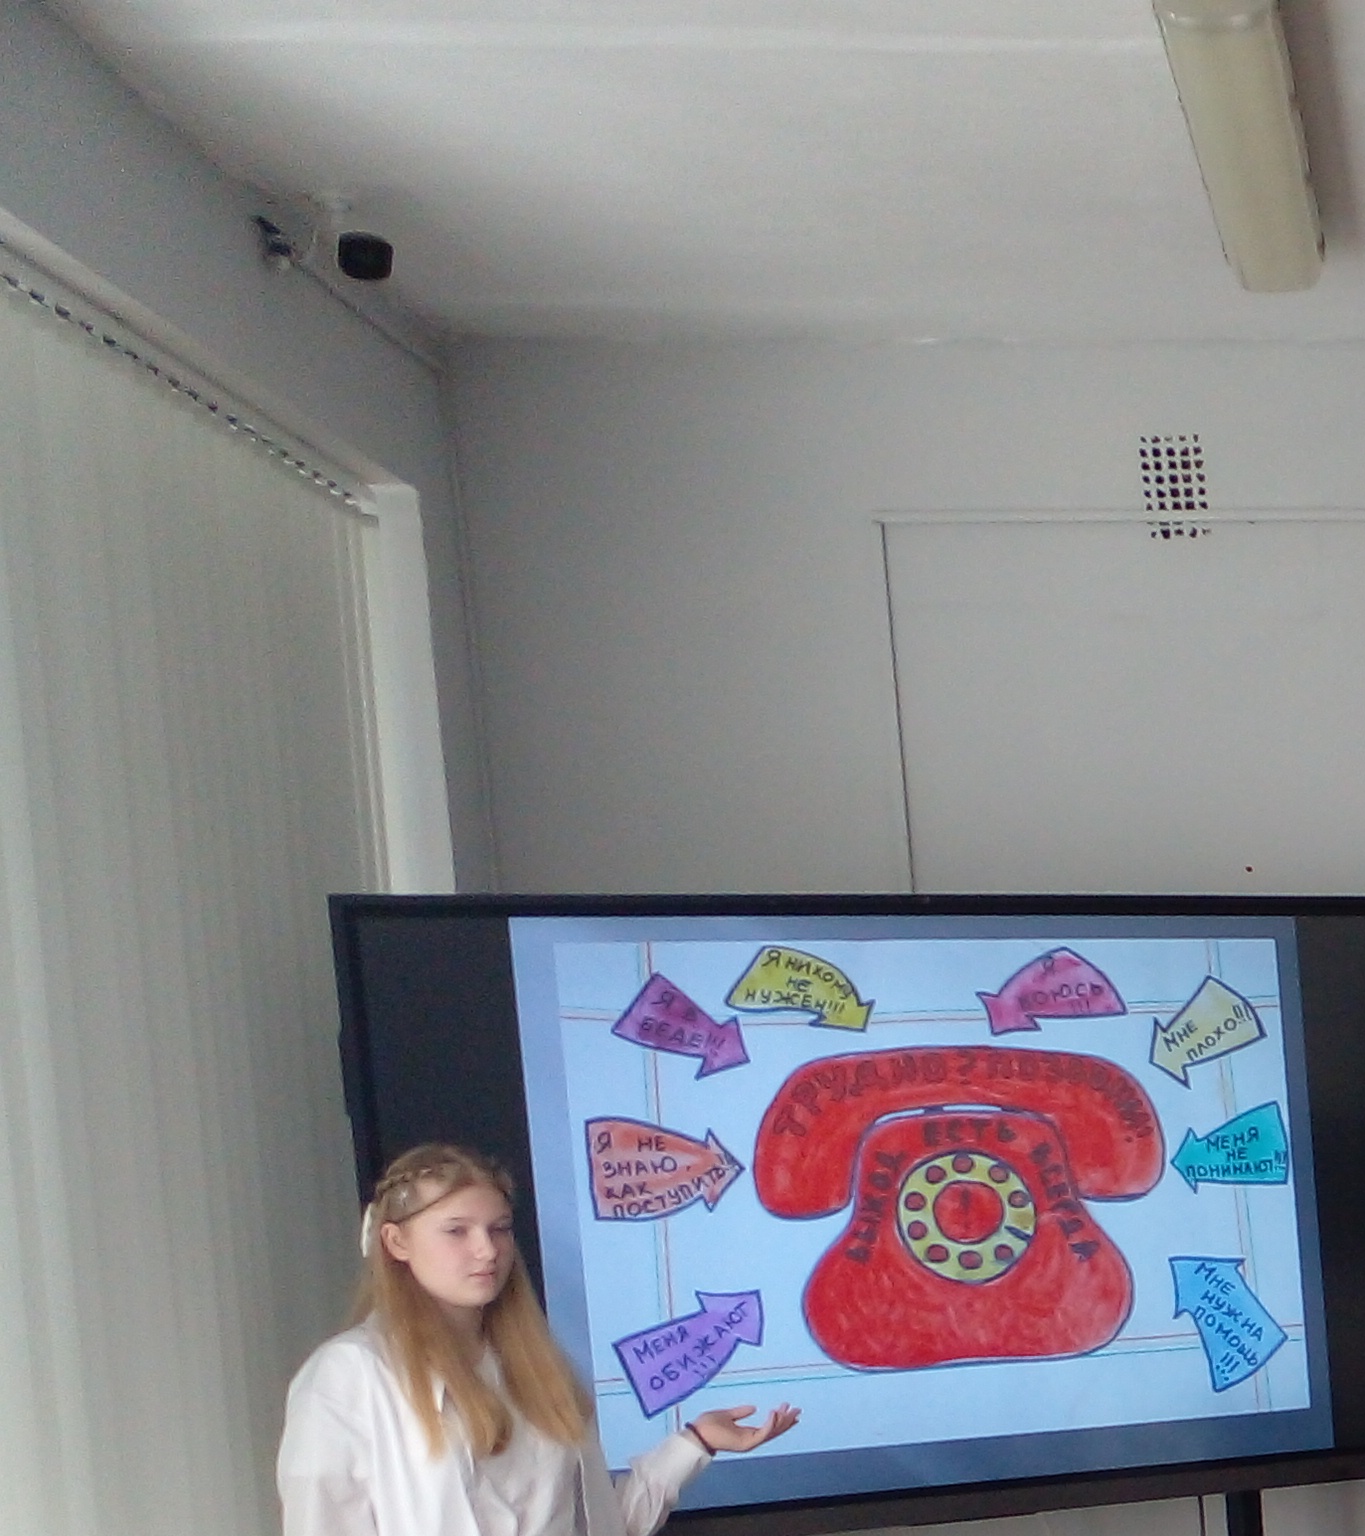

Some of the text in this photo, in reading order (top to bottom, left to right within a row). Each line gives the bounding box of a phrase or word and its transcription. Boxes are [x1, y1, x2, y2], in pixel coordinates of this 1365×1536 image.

[1163, 1018, 1199, 1052] МНЕ
[597, 1131, 667, 1154] Я НЕ
[1206, 1126, 1259, 1153] МЕНЯ
[1226, 1147, 1248, 1162] НЕ
[1194, 1262, 1236, 1296] МНЕ
[1200, 1290, 1264, 1342] НУЖНА
[632, 1324, 690, 1365] МЕНЯ
[650, 1300, 749, 1391] ОБИЖАЮТ
[1193, 1305, 1259, 1367] ПОМОЩЬ
